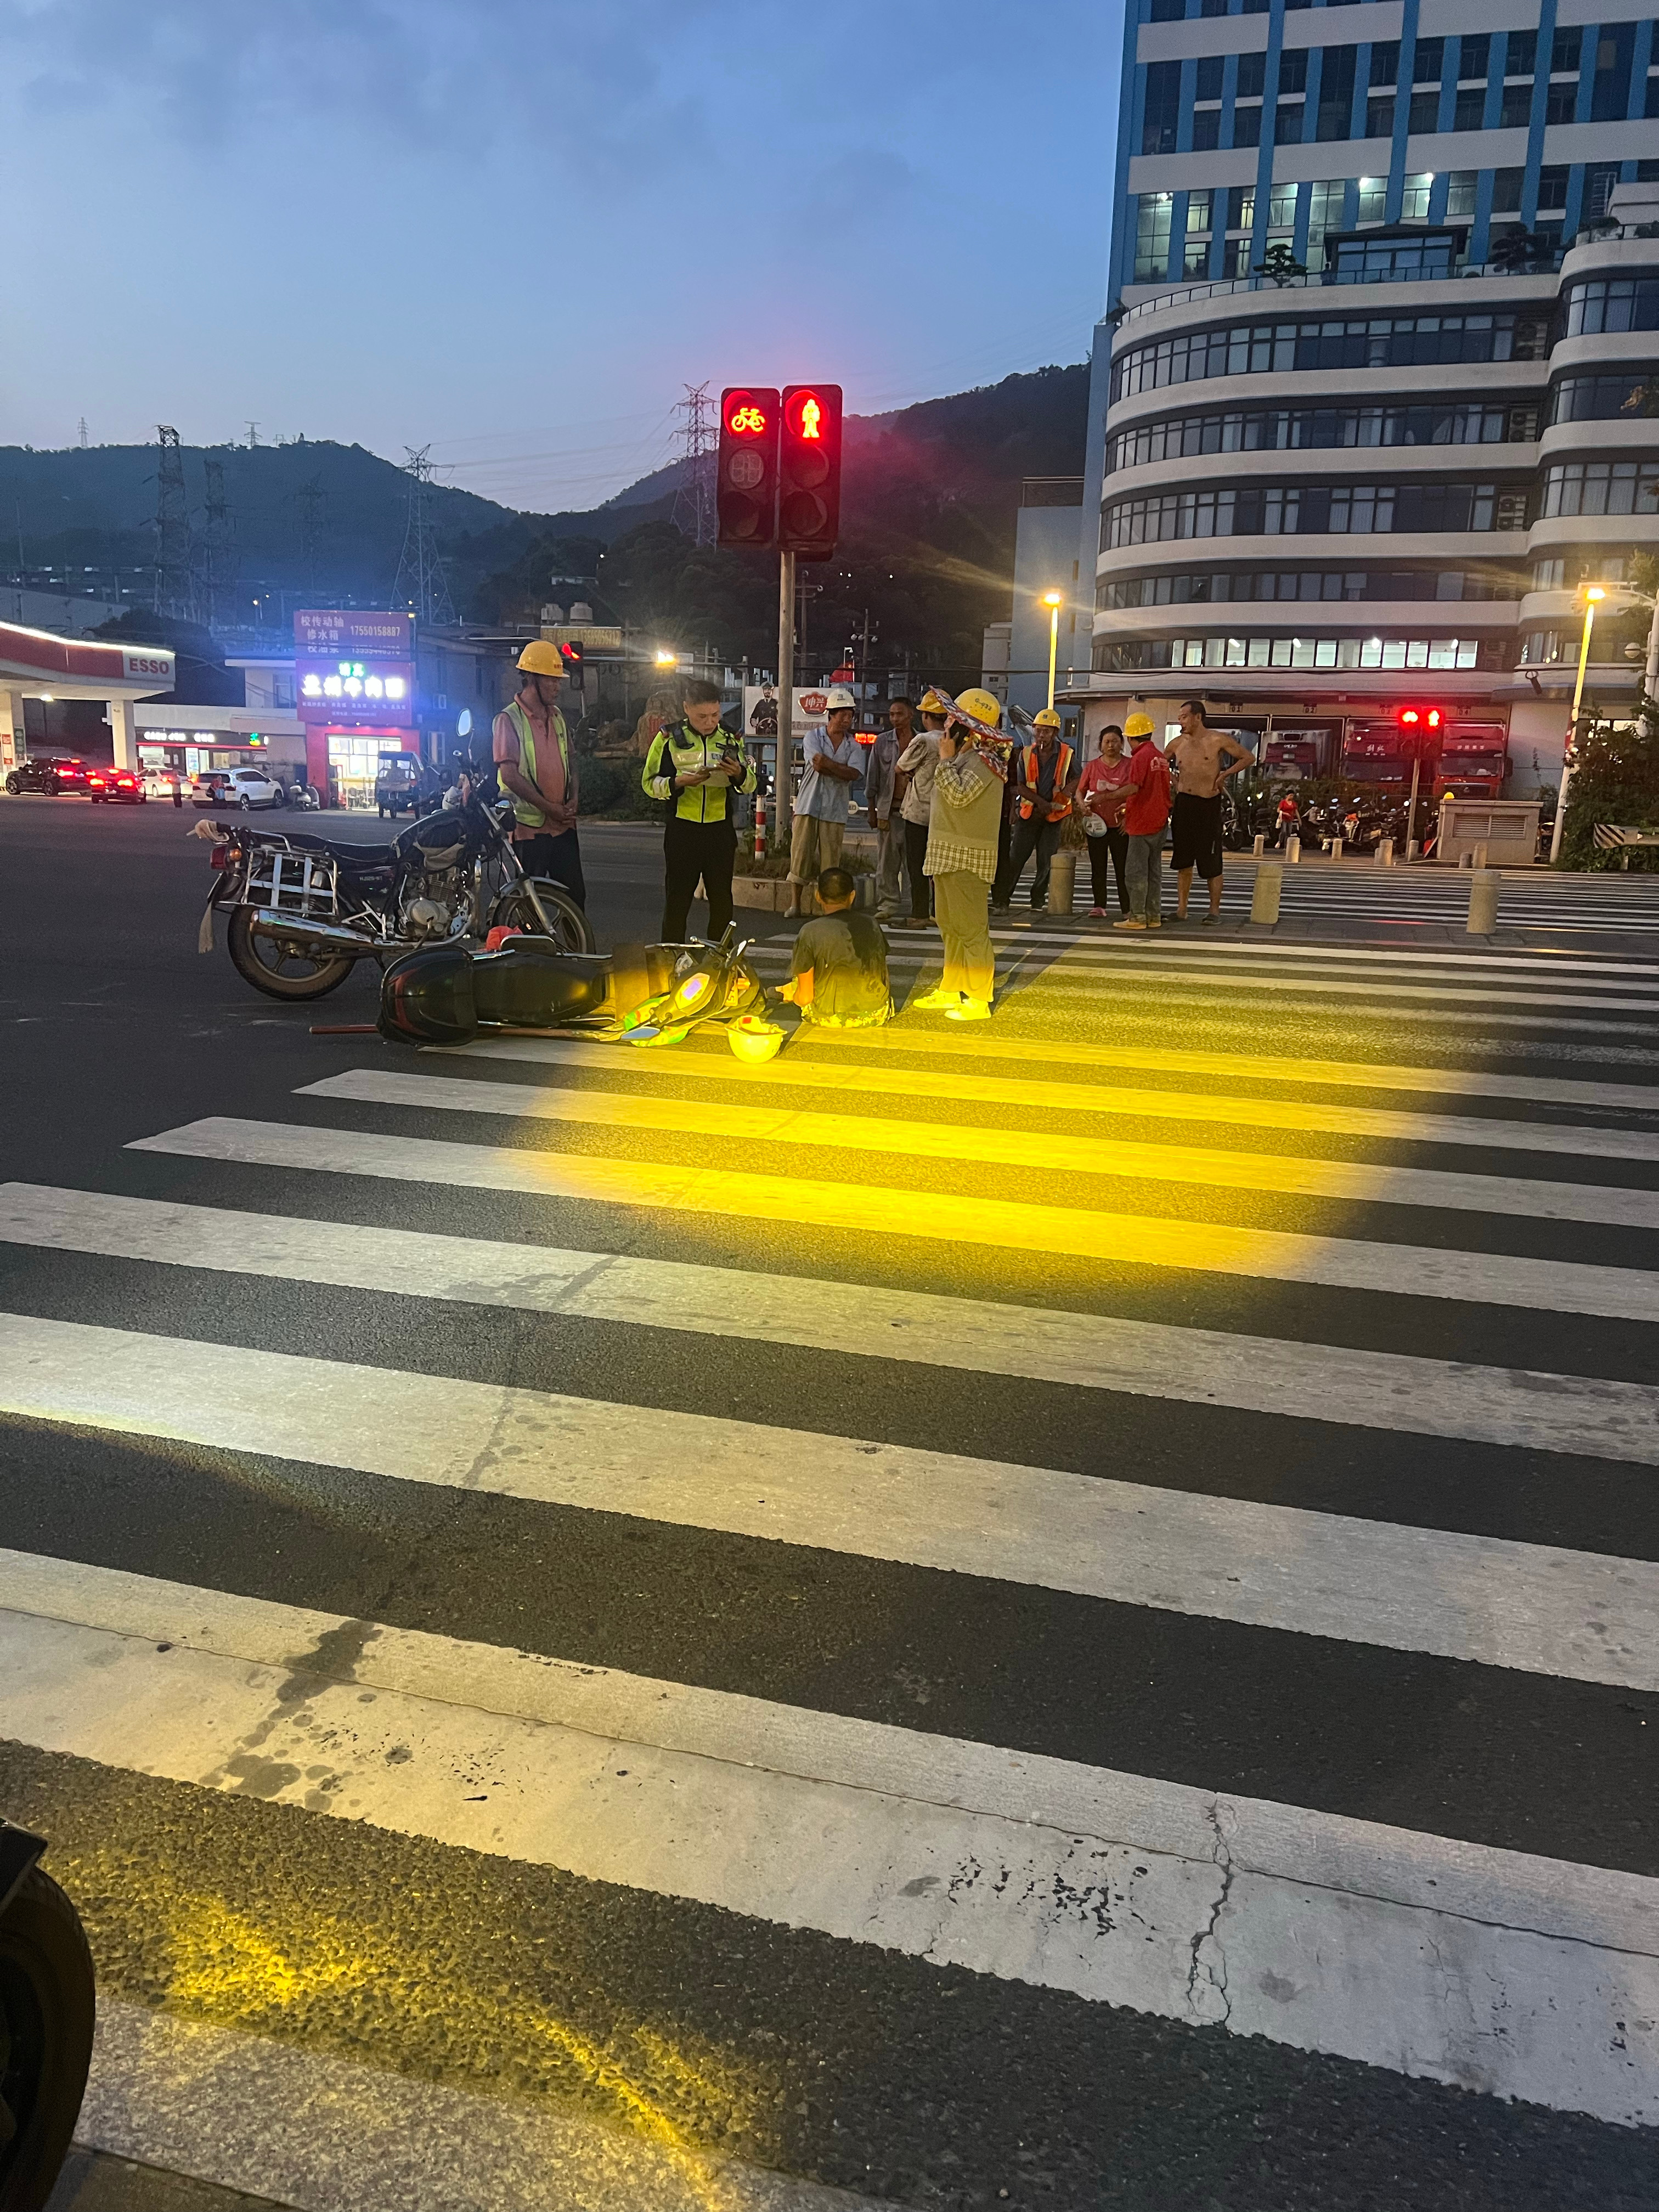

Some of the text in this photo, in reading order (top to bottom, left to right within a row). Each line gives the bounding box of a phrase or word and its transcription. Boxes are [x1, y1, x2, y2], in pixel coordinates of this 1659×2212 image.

[301, 616, 344, 628] 校传动轴
[307, 629, 338, 641] 修水箱
[129, 657, 170, 675] ESSO
